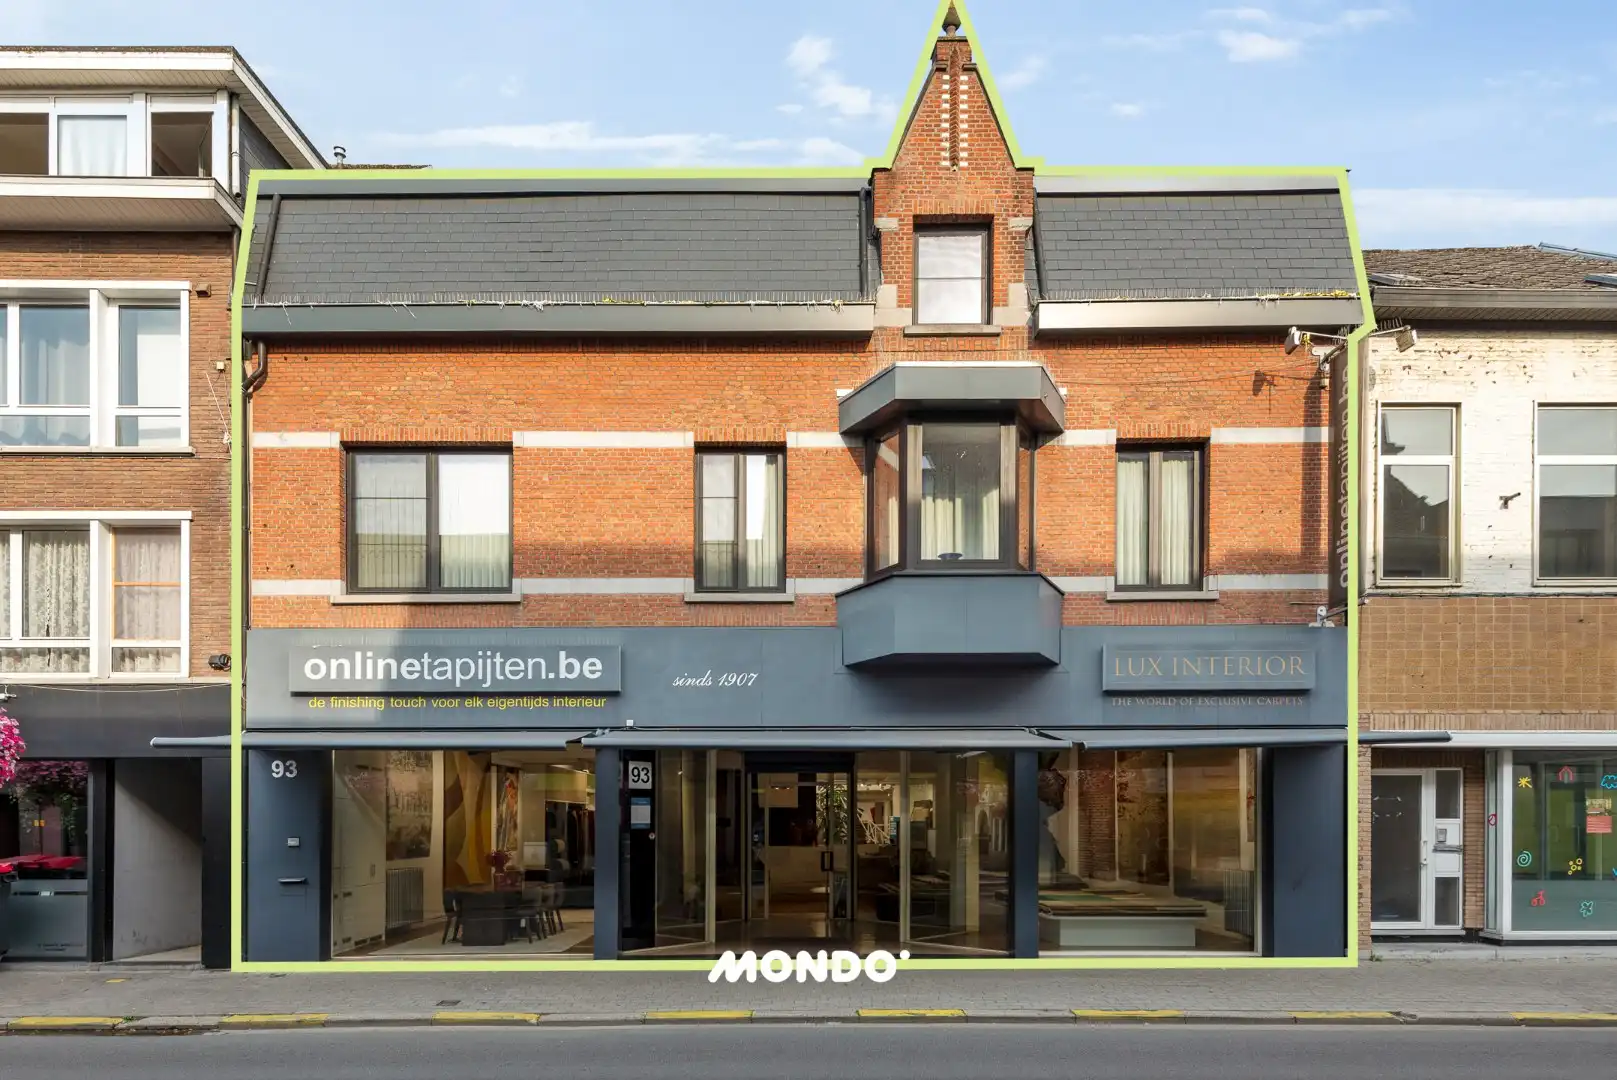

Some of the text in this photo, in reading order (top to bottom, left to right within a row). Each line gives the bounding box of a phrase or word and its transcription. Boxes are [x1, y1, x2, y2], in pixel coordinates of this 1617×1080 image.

[303, 650, 603, 688] onlinetapijten.be
[1114, 655, 1308, 677] LUX INTERIOR
[672, 670, 759, 687] sinds 1907
[308, 695, 606, 710] de finishing touch voor elk eigentijds interieur
[1112, 697, 1303, 706] THE WORLD OF EXCLUSIVE CARPETS
[271, 760, 298, 778] 93
[631, 766, 650, 783] 93
